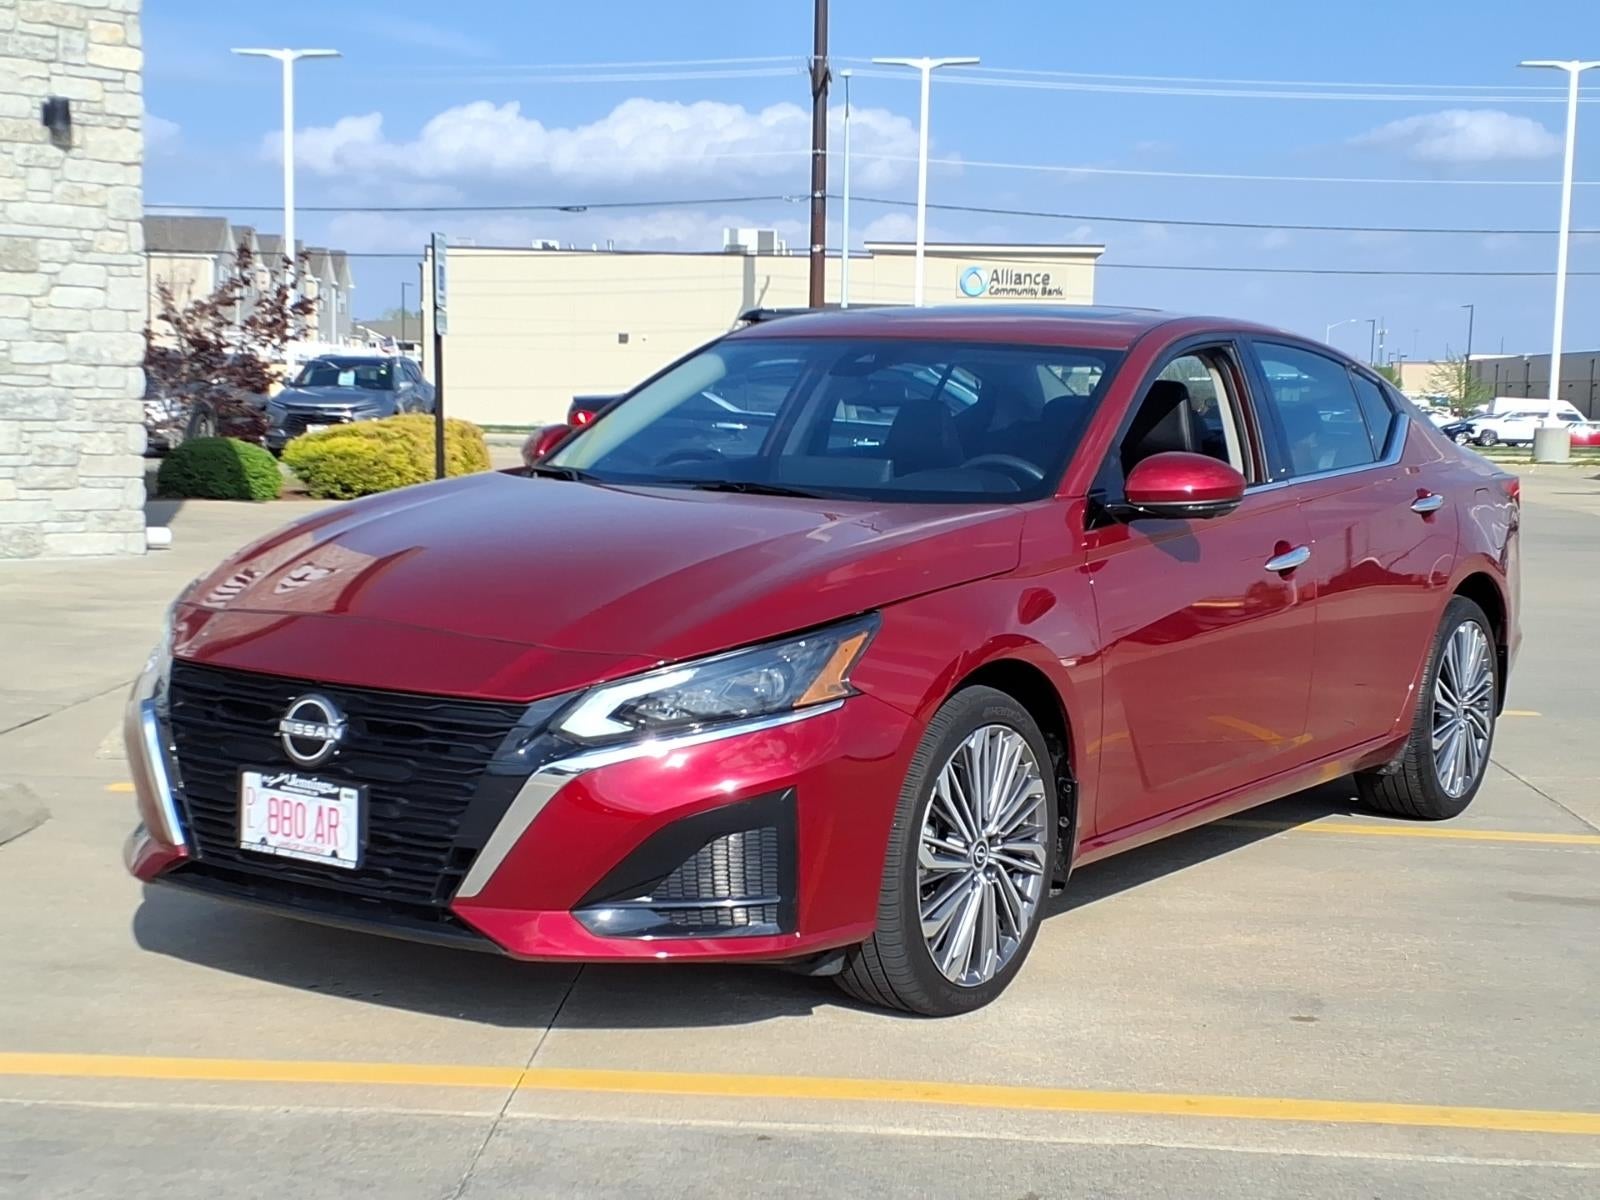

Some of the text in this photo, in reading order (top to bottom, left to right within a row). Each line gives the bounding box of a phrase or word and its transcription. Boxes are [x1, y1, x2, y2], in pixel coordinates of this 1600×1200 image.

[989, 268, 1050, 286] Alliance
[988, 286, 1063, 298] Community Bank
[283, 720, 342, 740] SSAN
[267, 797, 340, 848] 880 AR
